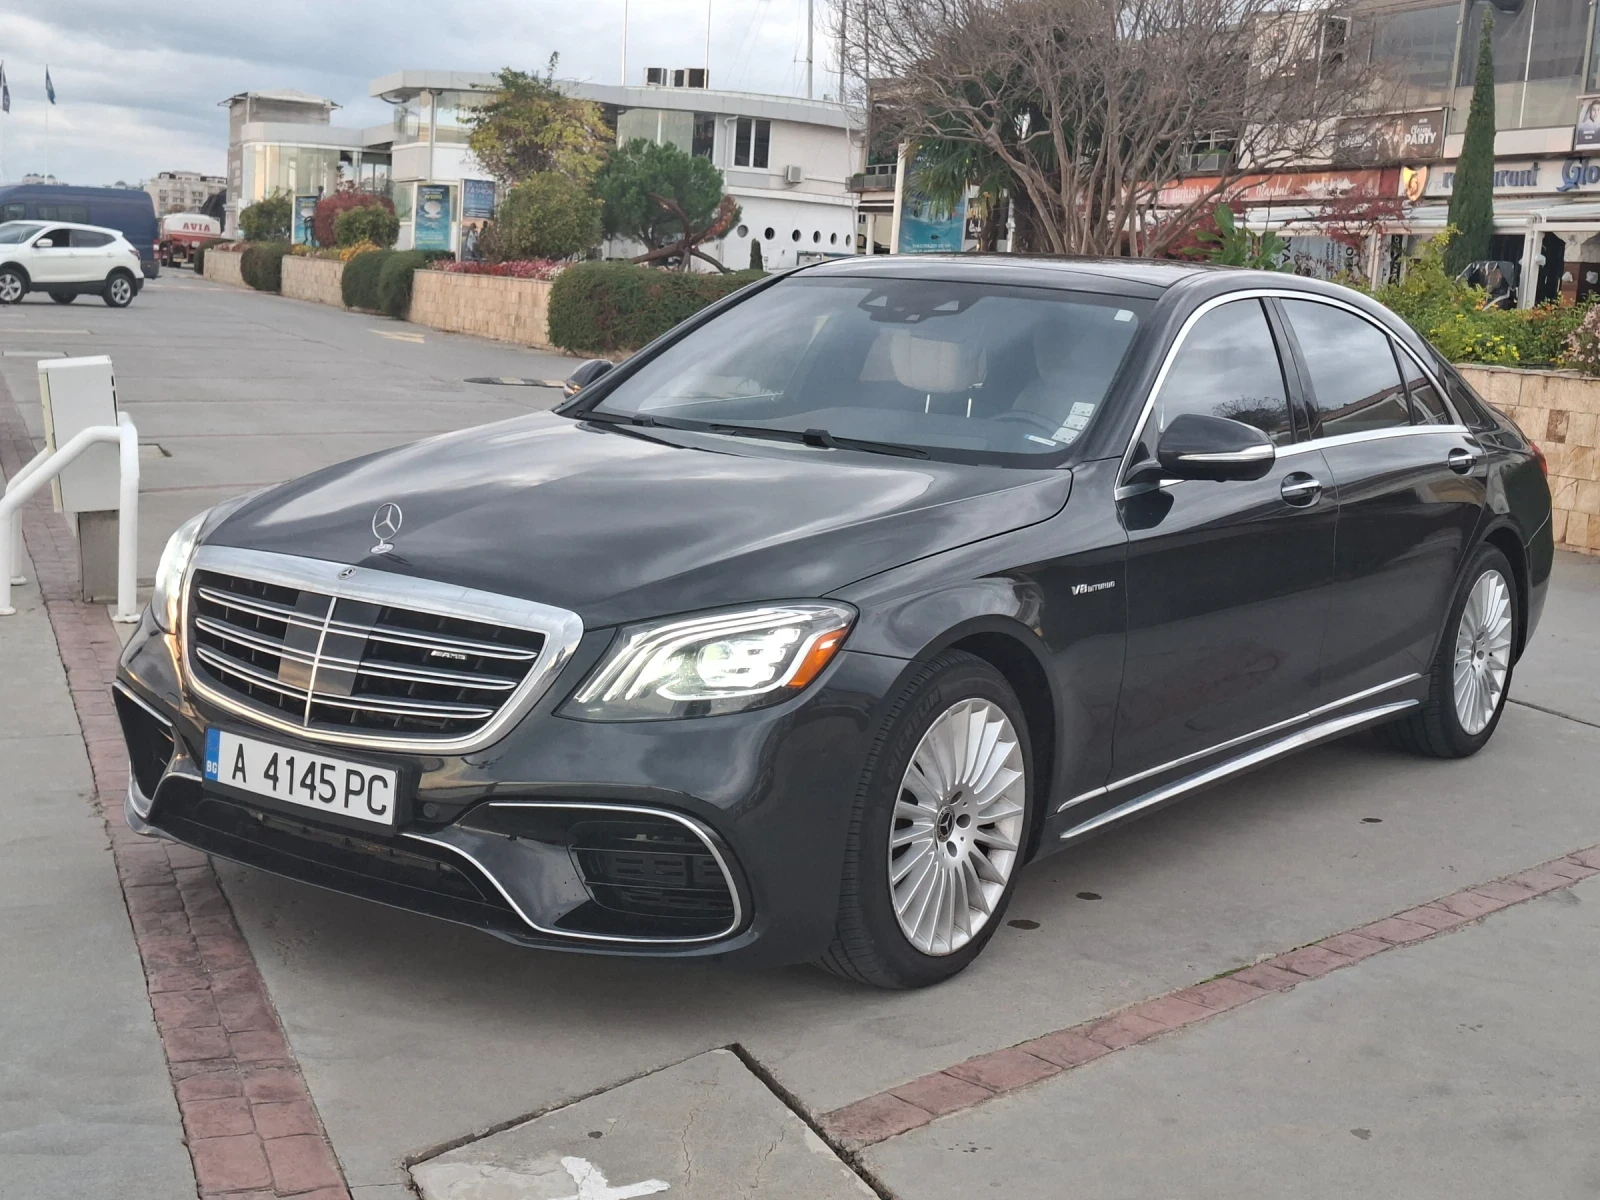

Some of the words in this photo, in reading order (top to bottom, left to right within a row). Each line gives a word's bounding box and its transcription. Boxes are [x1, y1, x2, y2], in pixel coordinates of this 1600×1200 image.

[1404, 131, 1437, 145] PARTY
[183, 222, 210, 232] AVIA
[206, 760, 217, 776] BG
[232, 743, 247, 783] A
[263, 752, 336, 803] 4145
[344, 768, 388, 816] PC
